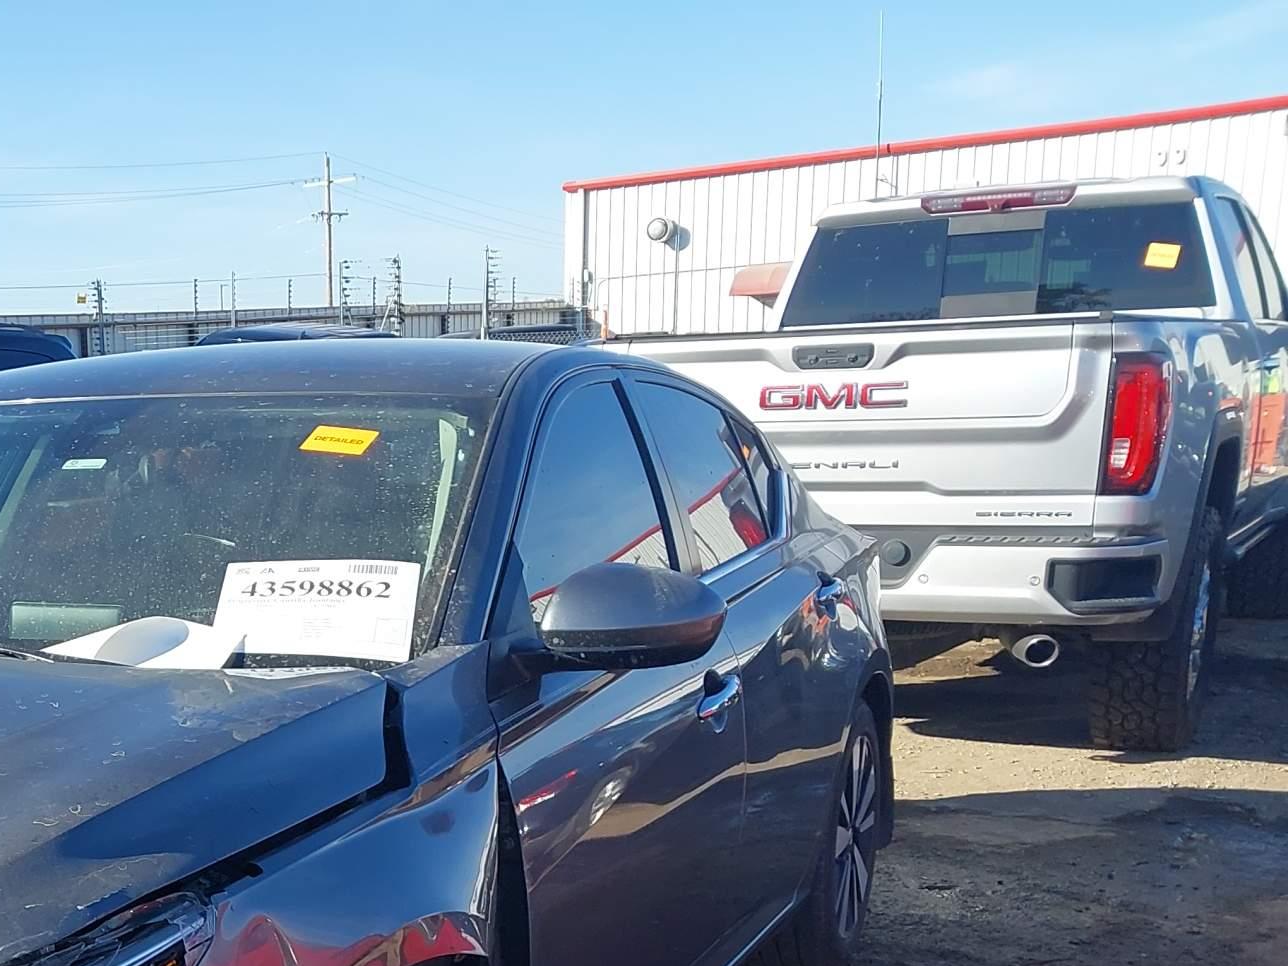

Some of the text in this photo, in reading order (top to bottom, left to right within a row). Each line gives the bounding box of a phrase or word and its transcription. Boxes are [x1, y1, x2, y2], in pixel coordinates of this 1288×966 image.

[759, 381, 908, 411] GMC
[313, 435, 365, 446] DETAILED
[791, 460, 899, 470] ENALI
[241, 580, 392, 599] 43598862
